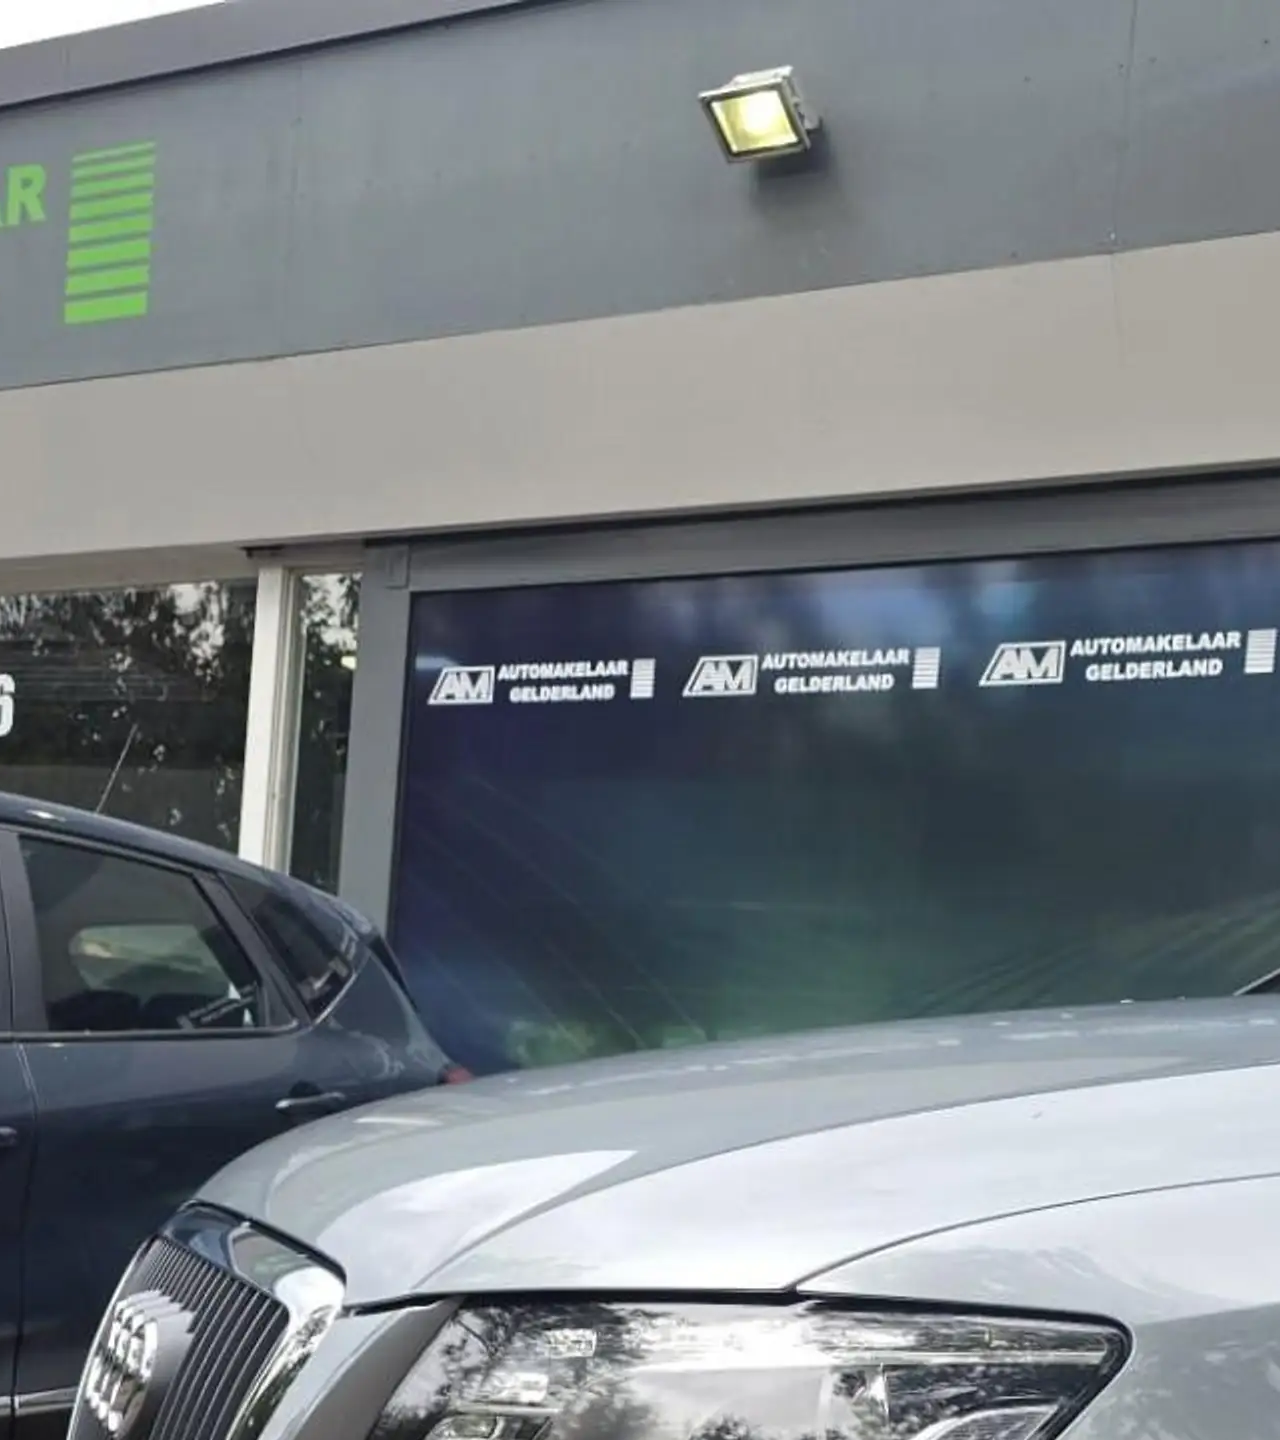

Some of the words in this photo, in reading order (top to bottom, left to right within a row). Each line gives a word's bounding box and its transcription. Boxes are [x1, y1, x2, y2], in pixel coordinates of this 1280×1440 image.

[1070, 631, 1242, 657] AUTOMAKELAAR
[497, 660, 630, 681] AUTOMAKELAAR
[761, 648, 910, 671] AUTOMAKELAAR
[1085, 658, 1224, 682] GELDERLAND
[509, 684, 616, 703] GELDERLAND
[774, 673, 895, 694] GELDERLAND
